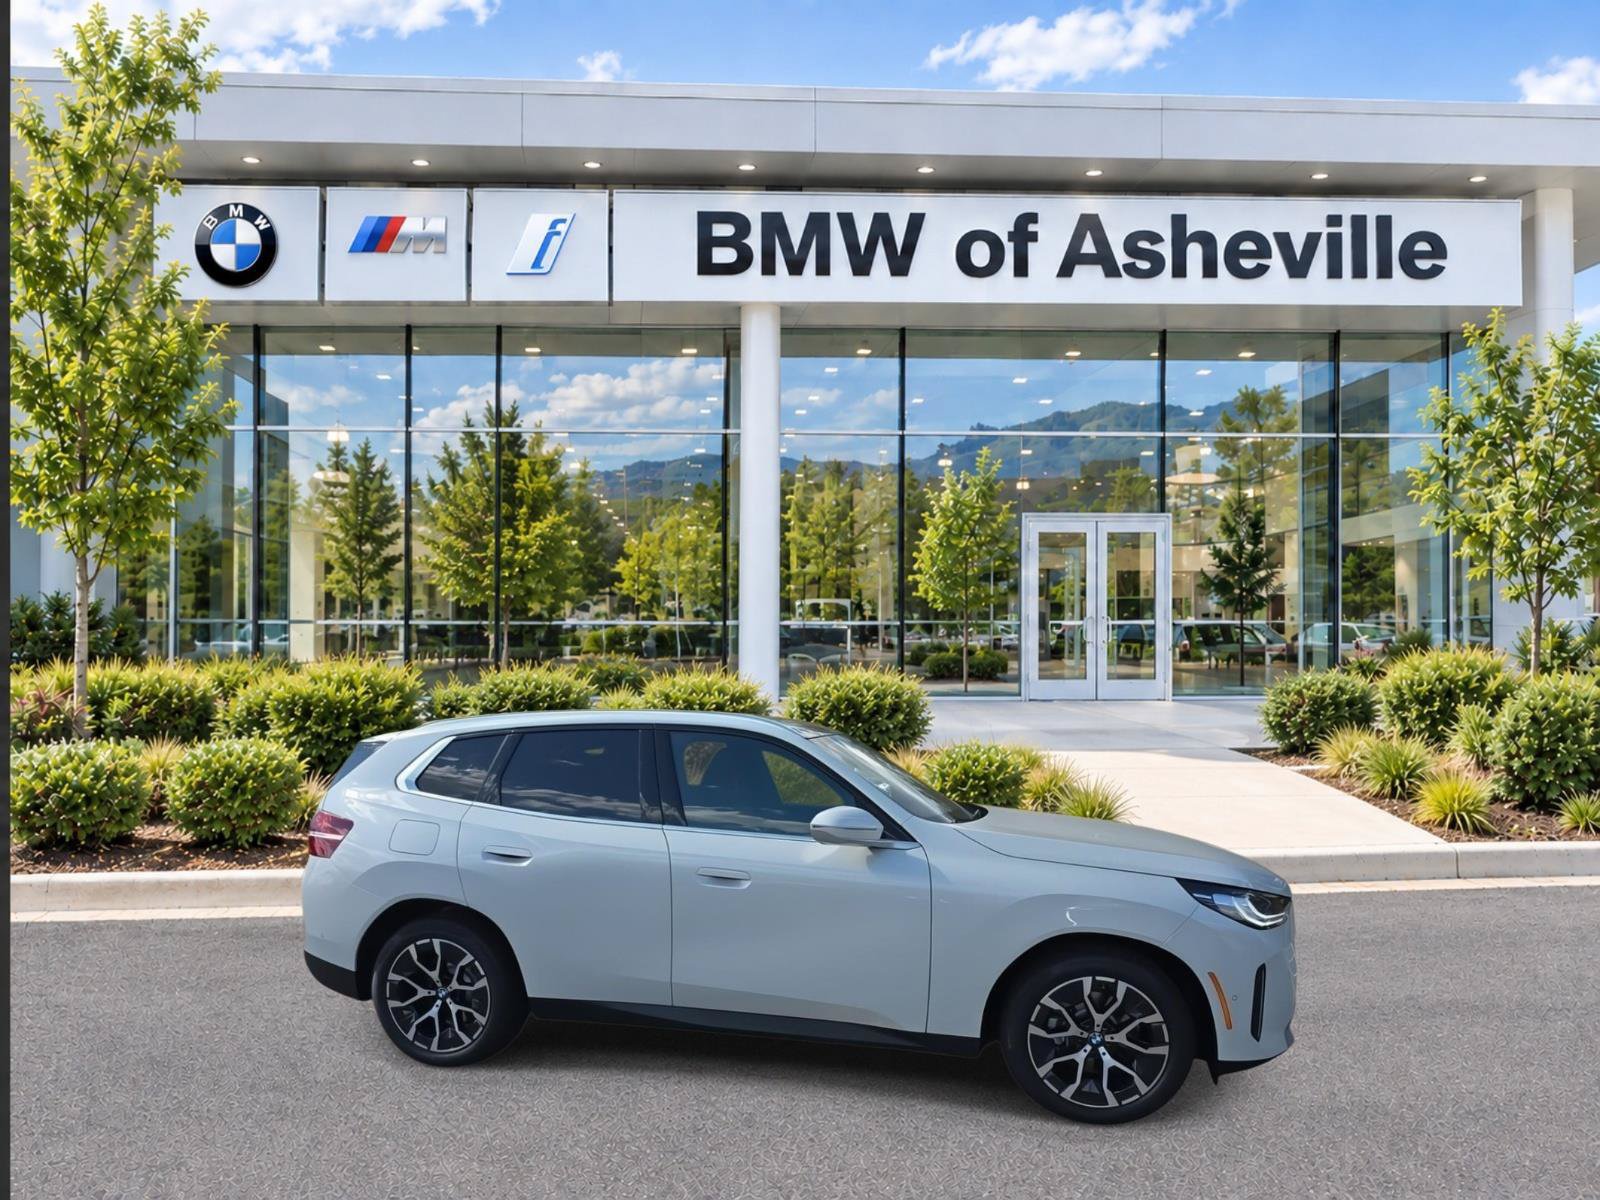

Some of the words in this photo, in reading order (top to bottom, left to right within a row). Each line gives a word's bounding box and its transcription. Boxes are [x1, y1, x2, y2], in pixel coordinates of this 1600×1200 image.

[203, 204, 271, 231] BMW
[696, 210, 926, 277] BMW
[955, 211, 1039, 279] of
[1056, 213, 1449, 281] Asheville
